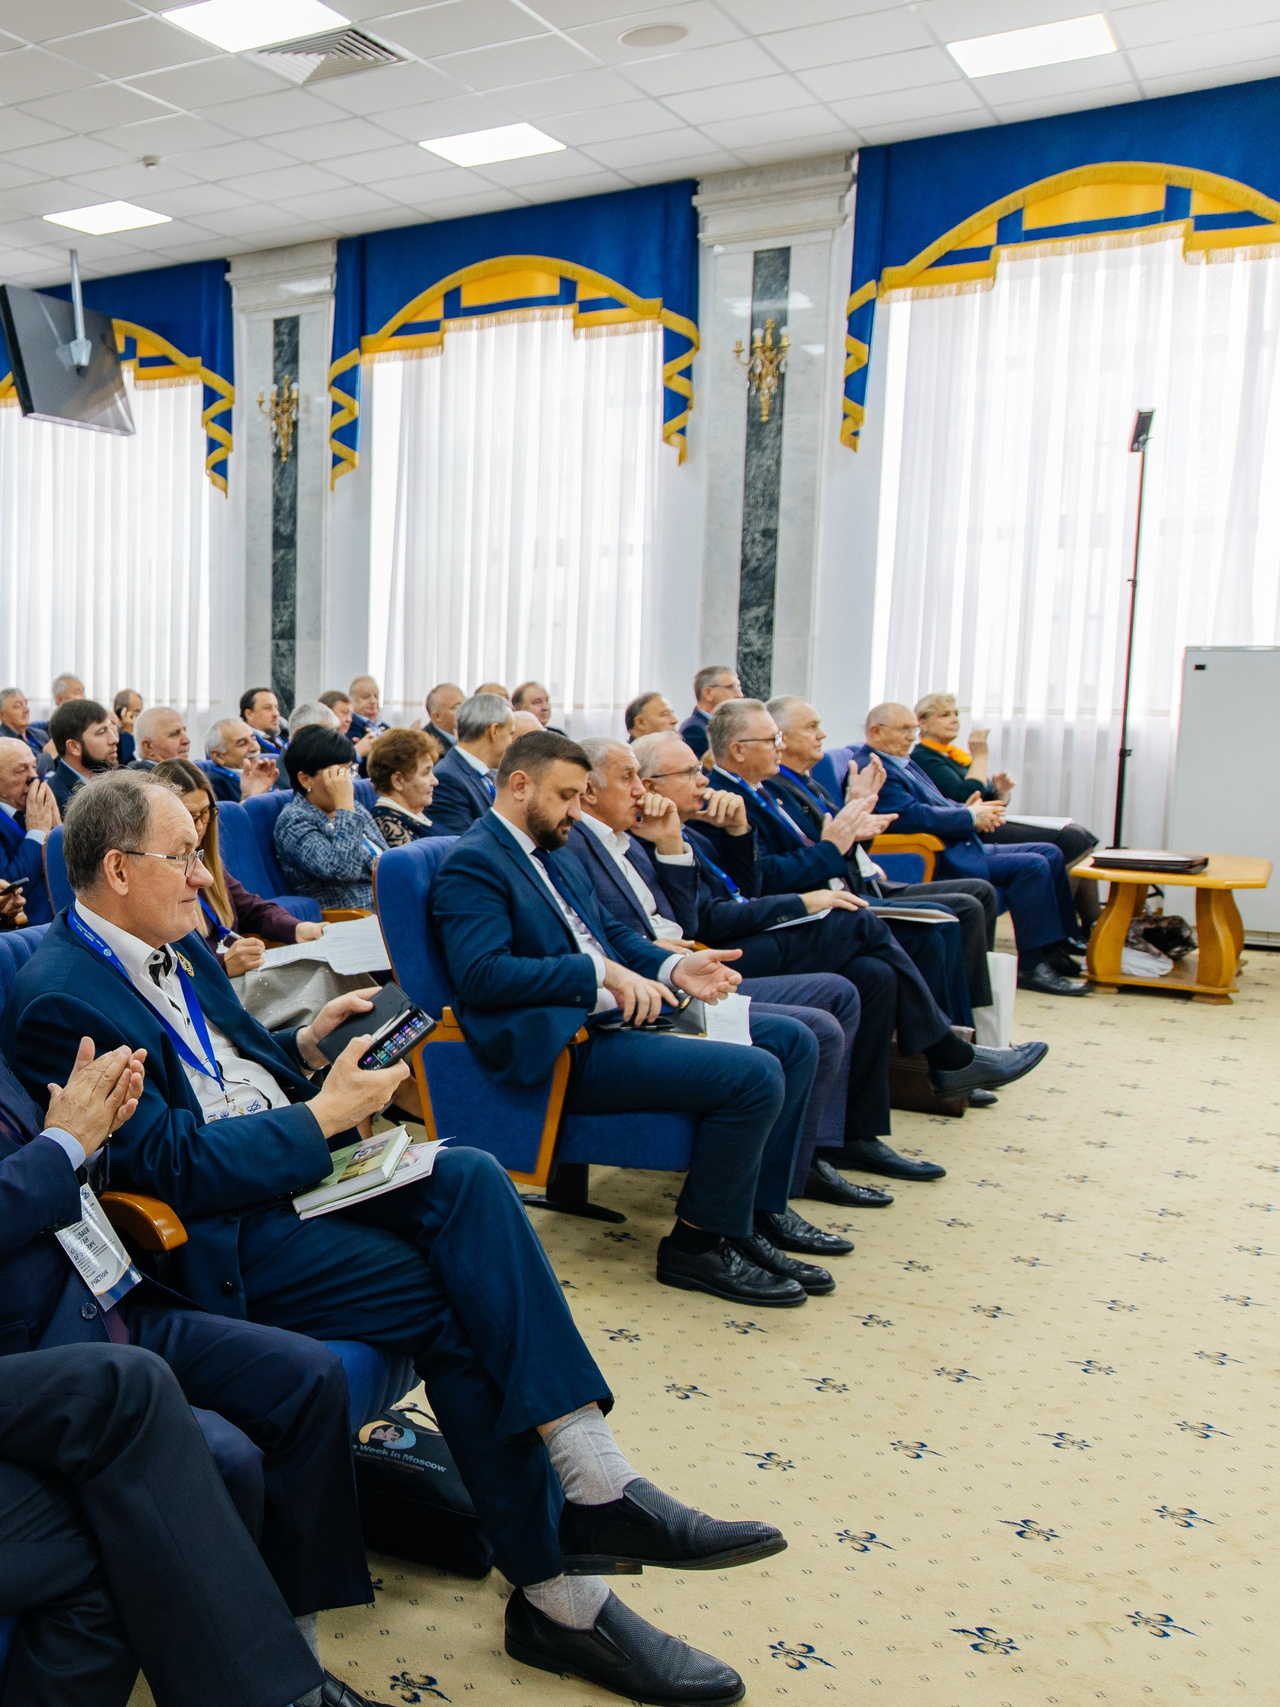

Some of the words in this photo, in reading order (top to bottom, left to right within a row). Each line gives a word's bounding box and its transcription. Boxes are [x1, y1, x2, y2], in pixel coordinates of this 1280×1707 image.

[360, 1444, 389, 1456] Week
[390, 1450, 401, 1460] in
[402, 1453, 447, 1473] Moscow
